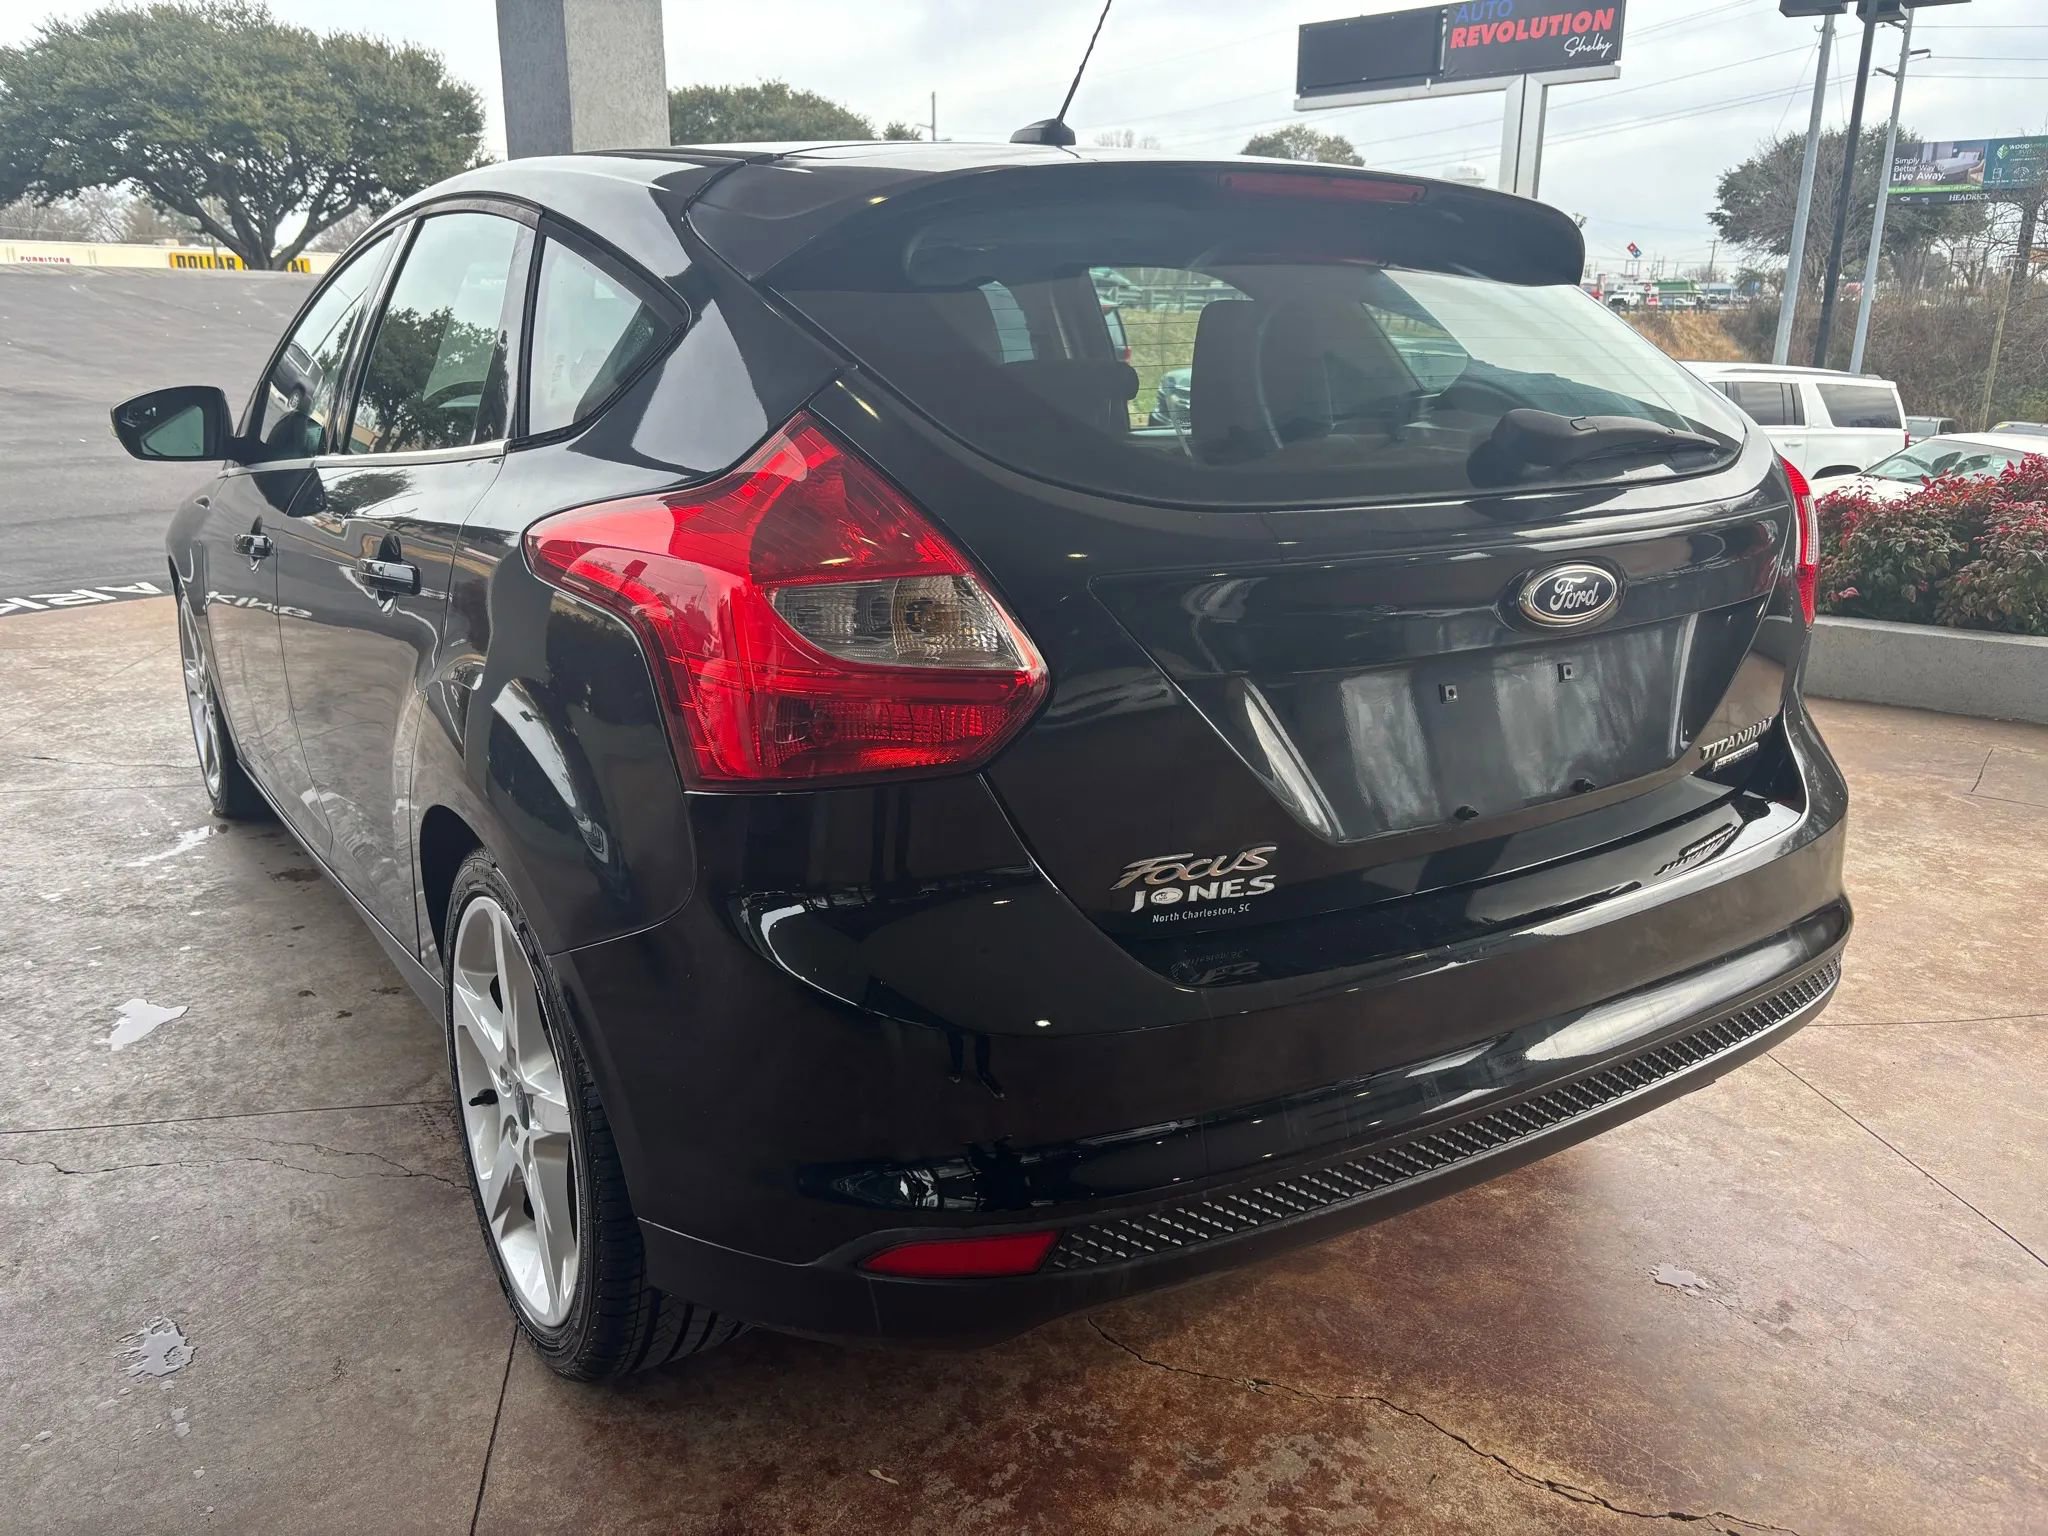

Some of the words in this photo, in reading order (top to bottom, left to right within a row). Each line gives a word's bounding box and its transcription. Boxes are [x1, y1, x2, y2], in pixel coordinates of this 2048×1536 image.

[1456, 0, 1514, 24] AUTO
[1451, 8, 1615, 49] REVOLUTION
[1564, 33, 1613, 58] Shelby
[1895, 157, 1920, 166] Simply
[1893, 172, 1914, 182] Live
[1916, 172, 1946, 181] Away.
[1949, 192, 1990, 202] HEADRICK
[20, 255, 70, 264] FURNITURE
[176, 255, 236, 270] DOLLAR
[1550, 577, 1600, 611] Ford
[1702, 716, 1773, 760] TITANIUM
[1110, 846, 1277, 890] FOCUS
[1131, 874, 1277, 913] JONES
[1152, 911, 1180, 923] North
[1182, 906, 1236, 920] Charleston,
[1238, 903, 1251, 913] SC
